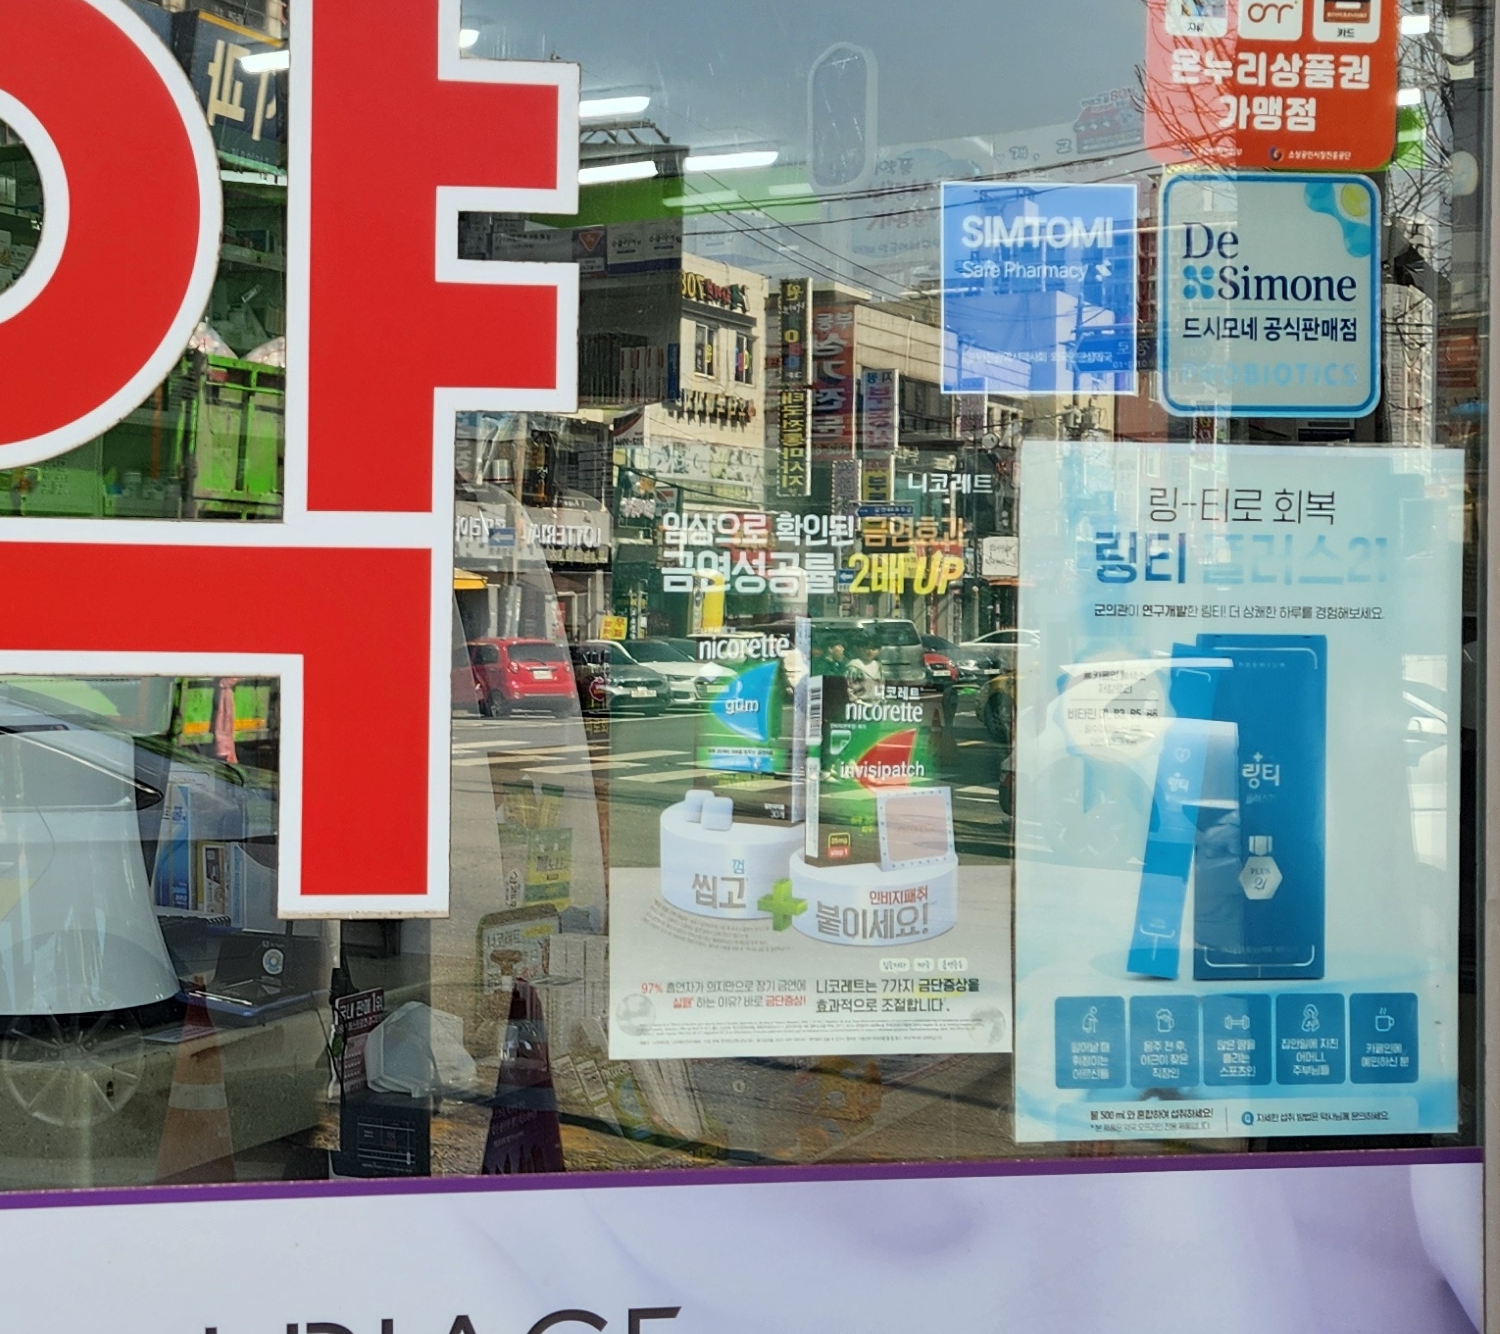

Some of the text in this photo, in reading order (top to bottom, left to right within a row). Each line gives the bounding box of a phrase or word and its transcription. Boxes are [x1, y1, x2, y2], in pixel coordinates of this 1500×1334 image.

[1172, 48, 1370, 90] 온누리상품권
[1219, 95, 1316, 132] 가맹점
[961, 215, 1113, 249] SIMTOMI
[1183, 223, 1239, 260] De
[962, 260, 1089, 283] Safe Pharmacy
[1218, 266, 1357, 302] Simone
[1183, 316, 1357, 343] 드시모네 공식판매점
[1183, 362, 1357, 387] PROBIOTICS
[908, 473, 993, 494] 니코레트
[1273, 488, 1336, 525] 회복
[662, 512, 768, 545] 임상으로
[776, 514, 854, 545] 확인된
[661, 552, 963, 595] 금연성공률 2배 UP
[1095, 532, 1186, 584] 링티
[1142, 604, 1199, 618] 연구개발한
[699, 633, 790, 661] nicorette
[846, 702, 923, 723] nicorette
[840, 761, 924, 779] invisipatch
[1242, 763, 1280, 789] 링티
[692, 873, 747, 910] 씹고
[816, 901, 929, 940] 붙이세요!
[816, 977, 980, 994] 니코레트는 7가지 금단증상을
